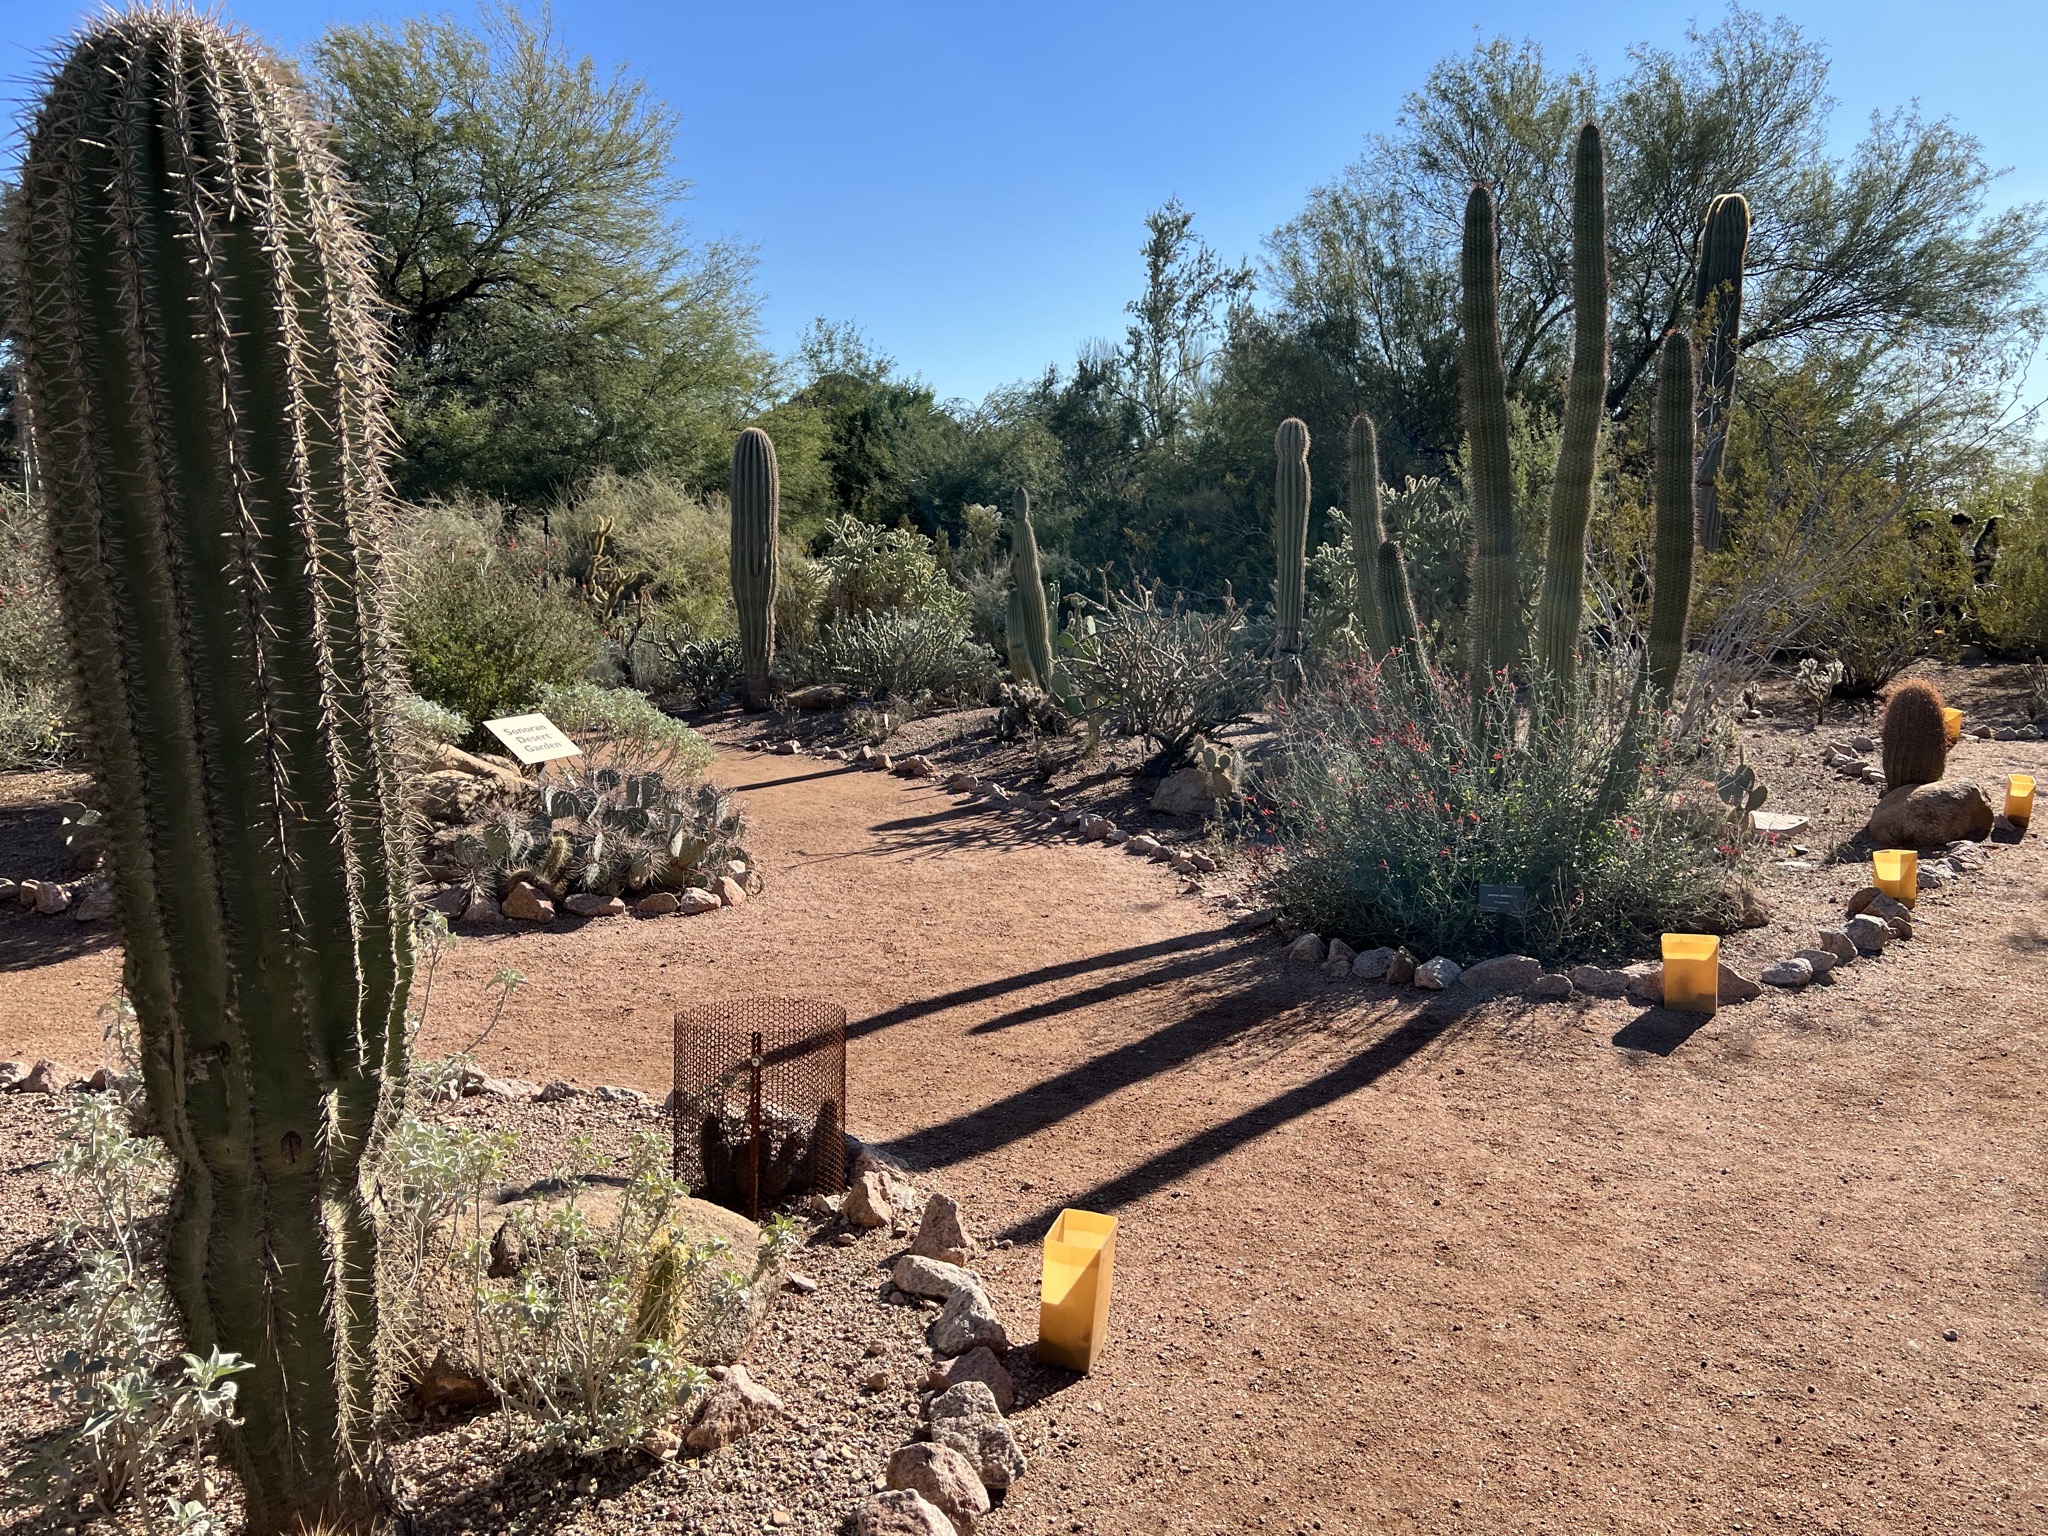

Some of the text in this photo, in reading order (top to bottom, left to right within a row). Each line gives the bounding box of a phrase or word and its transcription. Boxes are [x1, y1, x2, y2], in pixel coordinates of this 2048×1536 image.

[503, 724, 547, 735] Sonoran
[515, 733, 552, 744] Desert
[524, 742, 562, 752] Garden
